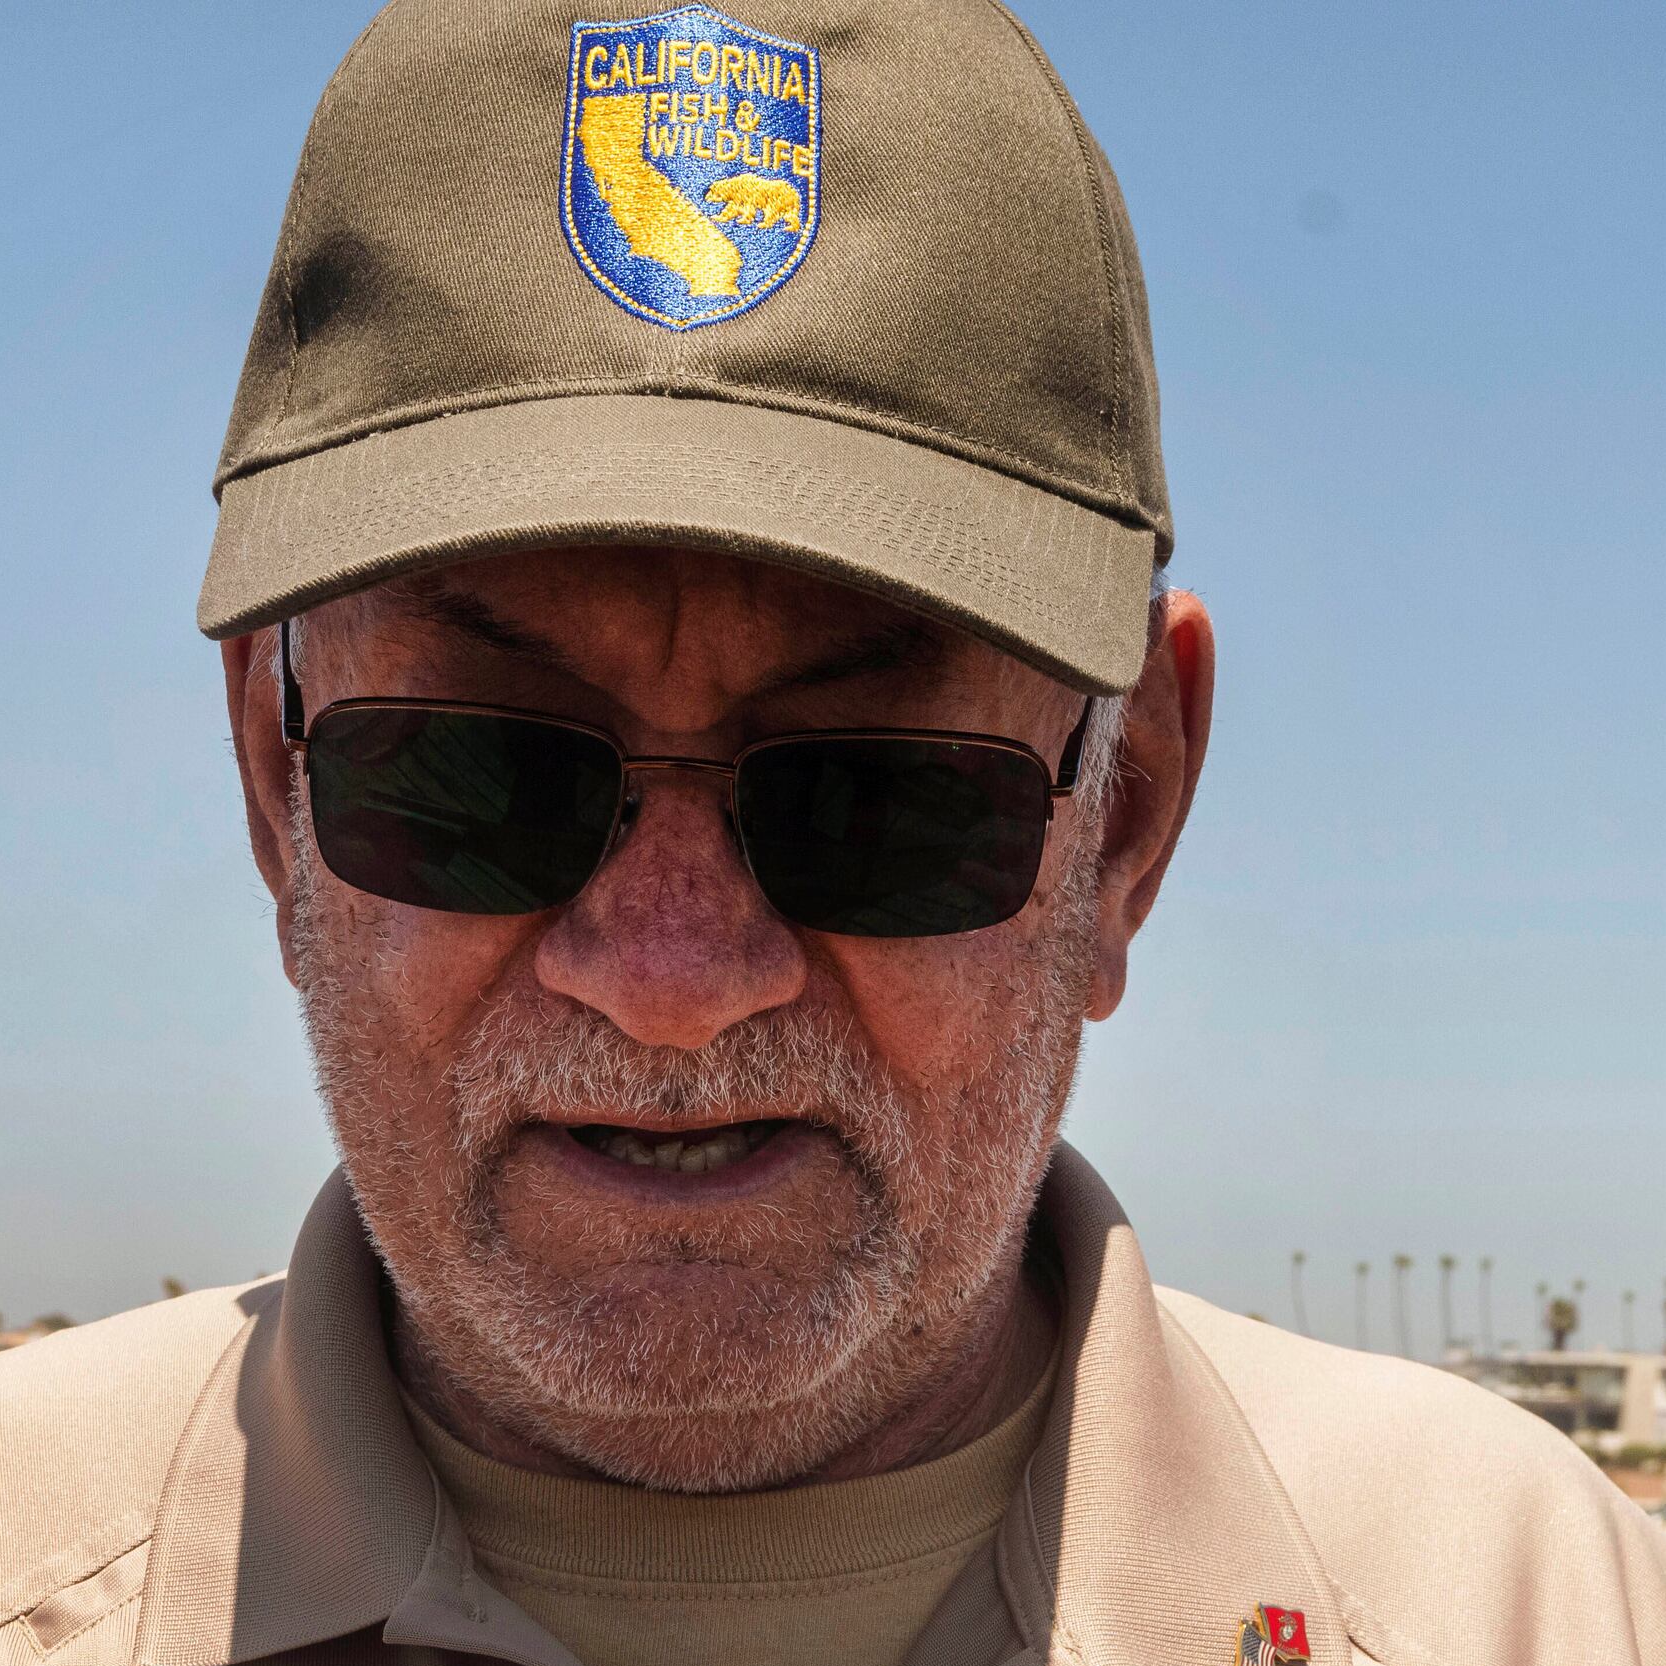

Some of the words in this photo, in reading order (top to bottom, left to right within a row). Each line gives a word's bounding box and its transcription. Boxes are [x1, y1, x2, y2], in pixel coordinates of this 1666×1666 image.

[584, 40, 806, 105] CALIFORNIA
[648, 92, 728, 126] FISH
[735, 101, 761, 132] &
[646, 126, 813, 177] WILDLIFE
